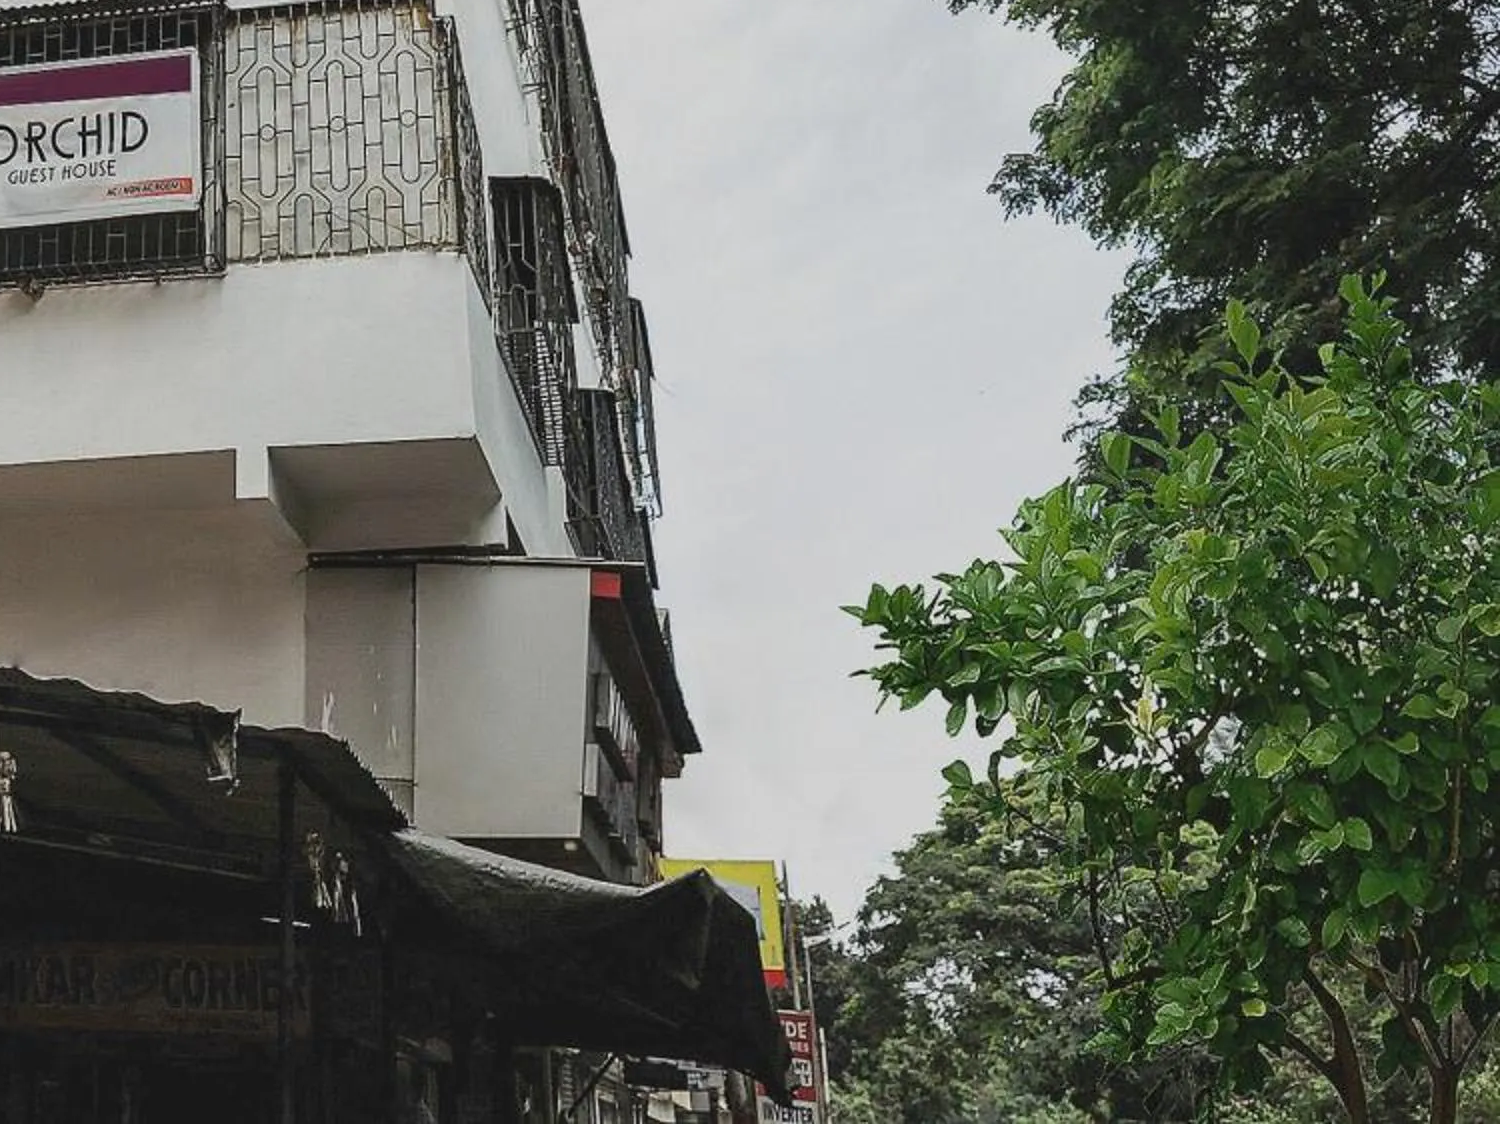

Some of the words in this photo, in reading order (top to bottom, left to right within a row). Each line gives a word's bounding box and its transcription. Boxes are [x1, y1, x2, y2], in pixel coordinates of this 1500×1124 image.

[7, 166, 55, 185] GUEST
[61, 159, 117, 181] HOUSE
[781, 1020, 807, 1039] DE
